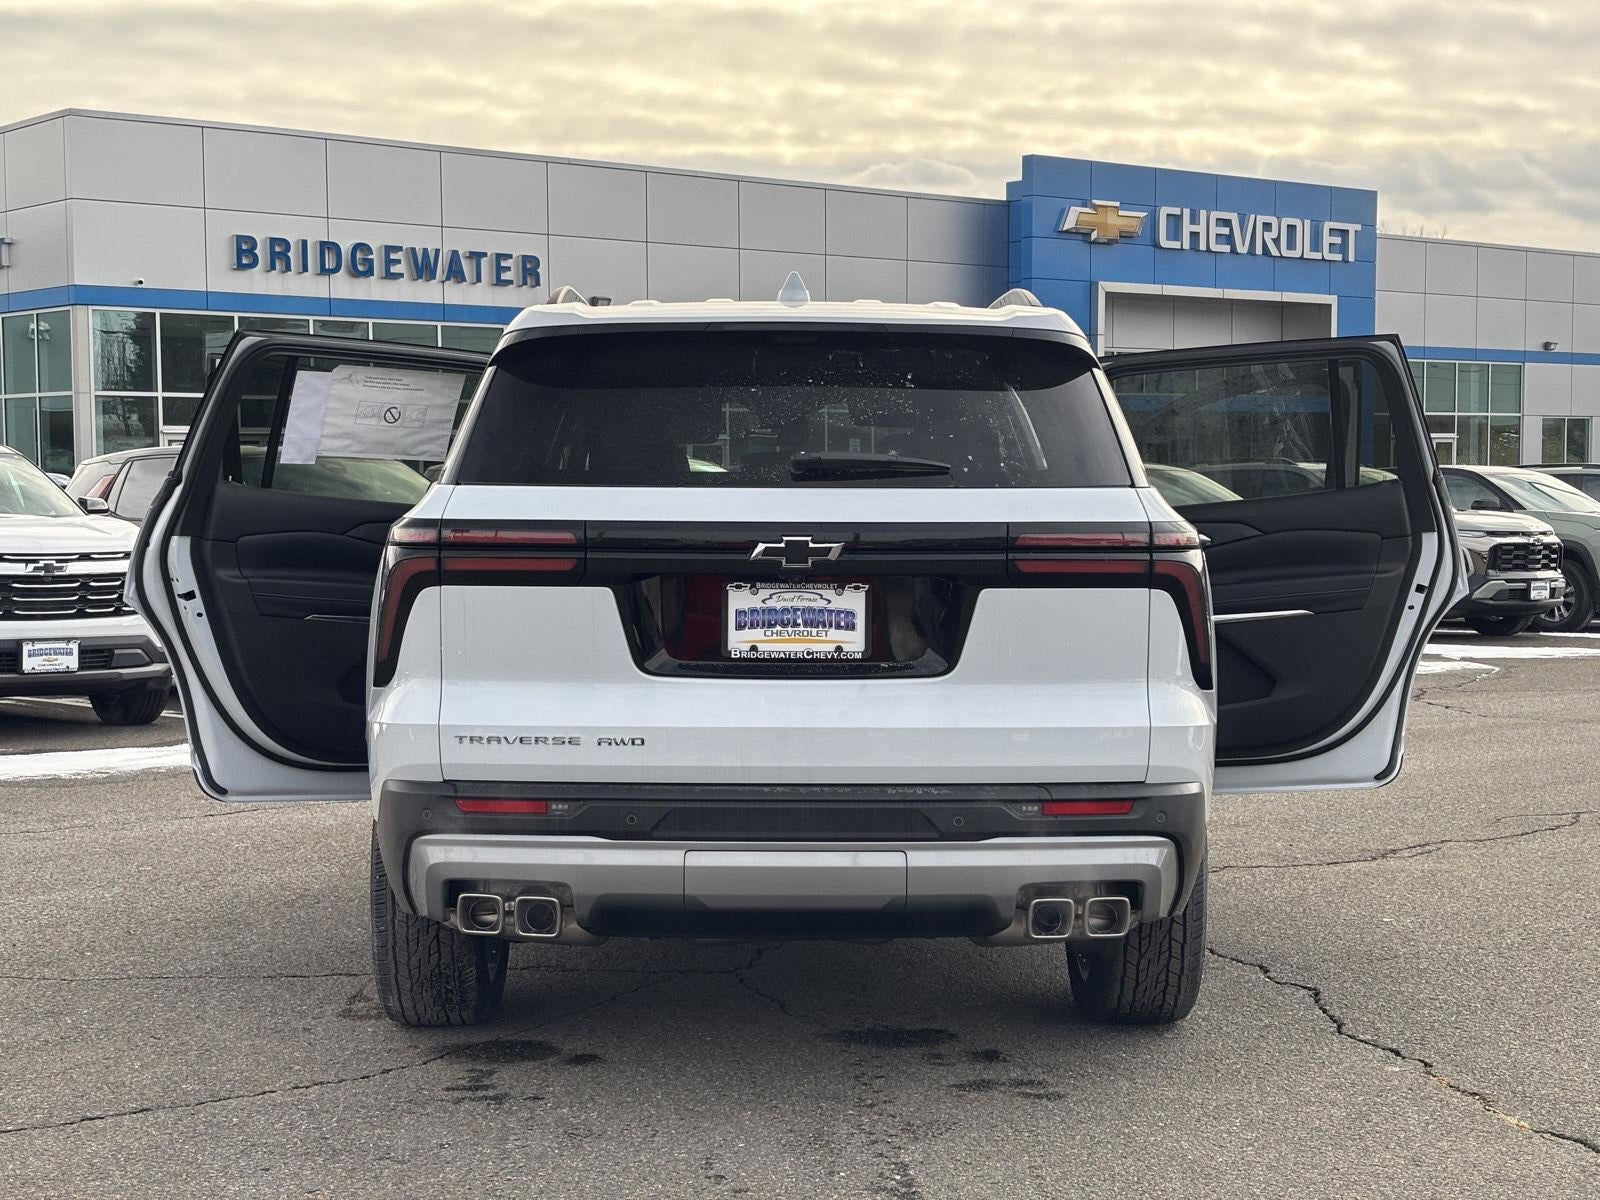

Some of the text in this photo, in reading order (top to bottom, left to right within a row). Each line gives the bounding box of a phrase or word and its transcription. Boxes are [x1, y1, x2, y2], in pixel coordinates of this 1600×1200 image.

[1157, 206, 1362, 263] CHEVROLET
[232, 234, 542, 288] BRIDGEWATER
[775, 594, 796, 602] David
[735, 606, 857, 631] BRIDGEWATER
[28, 647, 73, 658] BRIDGEWATER
[731, 648, 862, 659] BRIDGEWATERCHEVY.COM
[454, 735, 645, 747] TRAVERSE AWD
